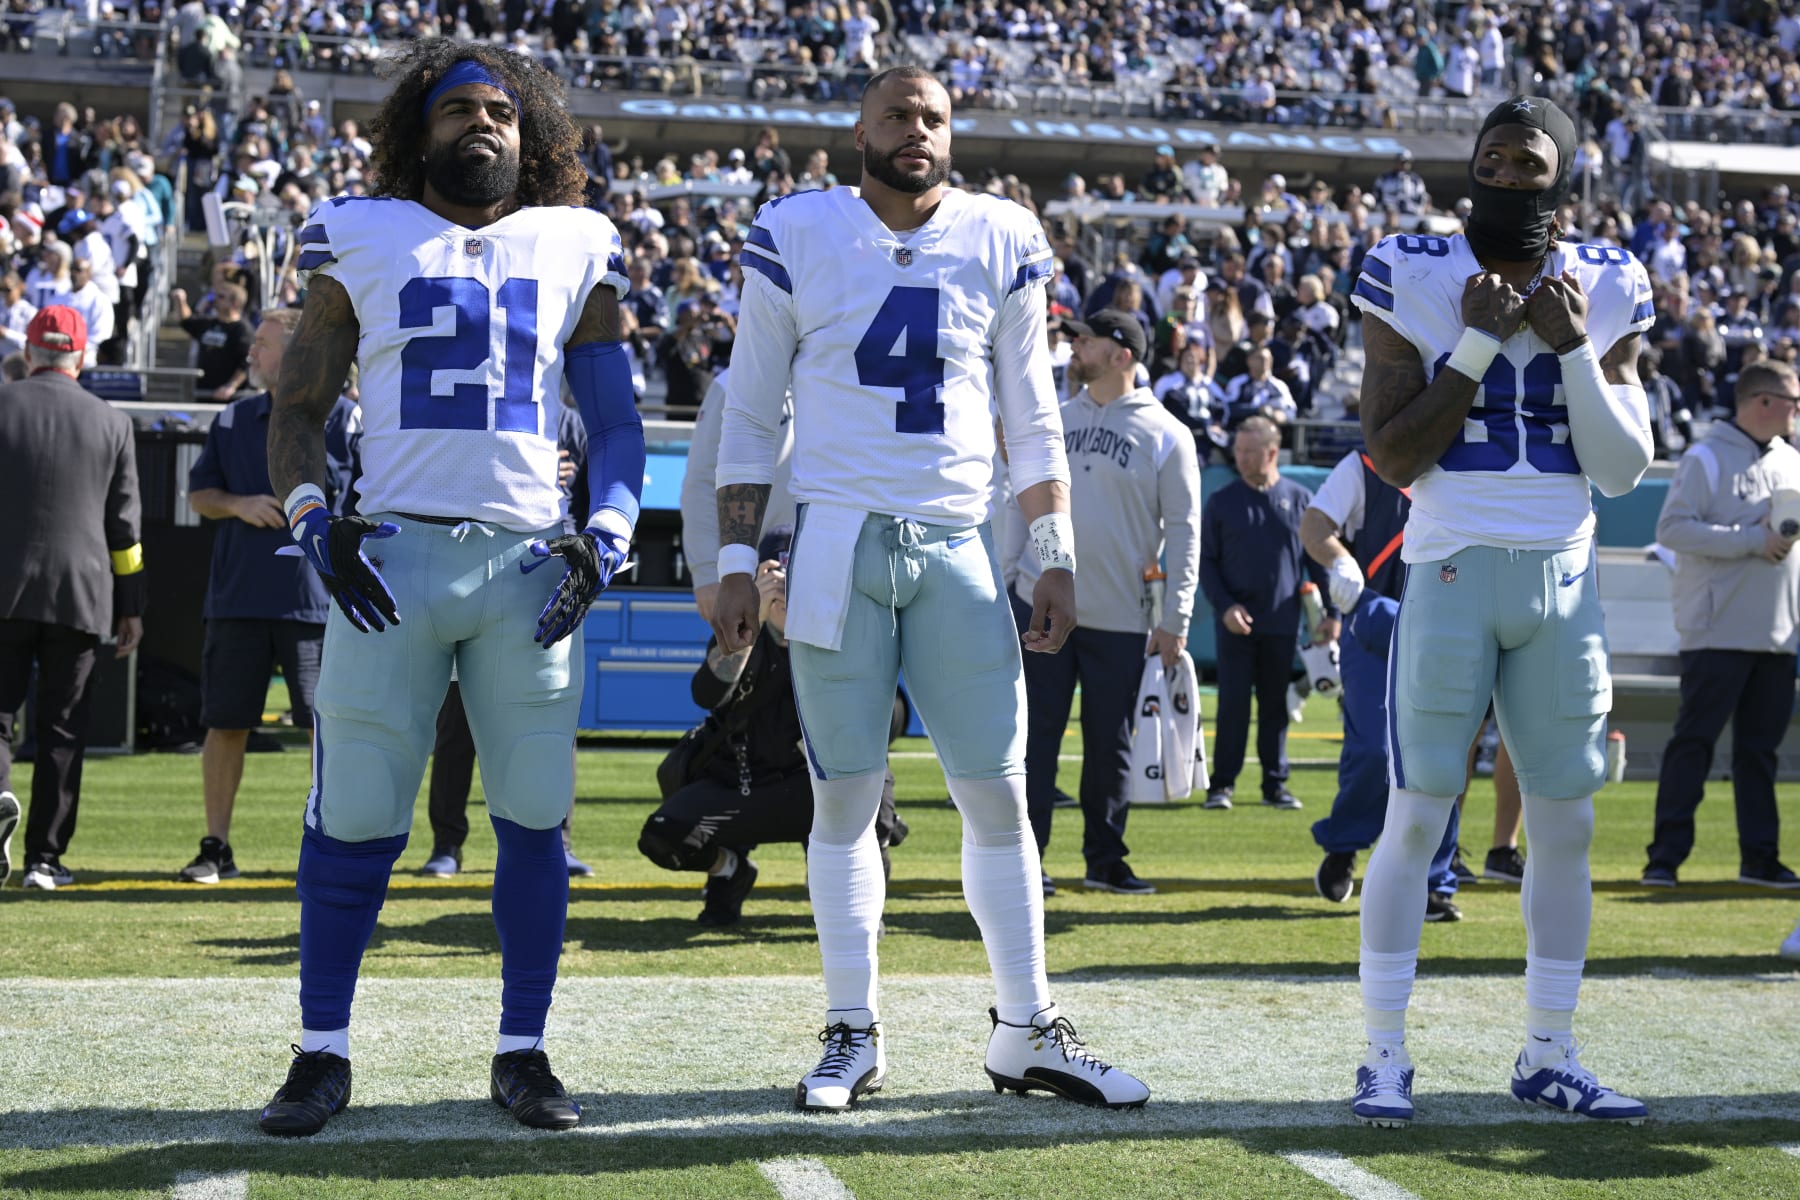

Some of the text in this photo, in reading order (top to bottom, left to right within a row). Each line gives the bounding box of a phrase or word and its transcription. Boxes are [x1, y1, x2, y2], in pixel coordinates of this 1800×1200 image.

[398, 276, 539, 435] 21
[854, 285, 946, 434] 4
[1064, 427, 1132, 469] OWBOYS
